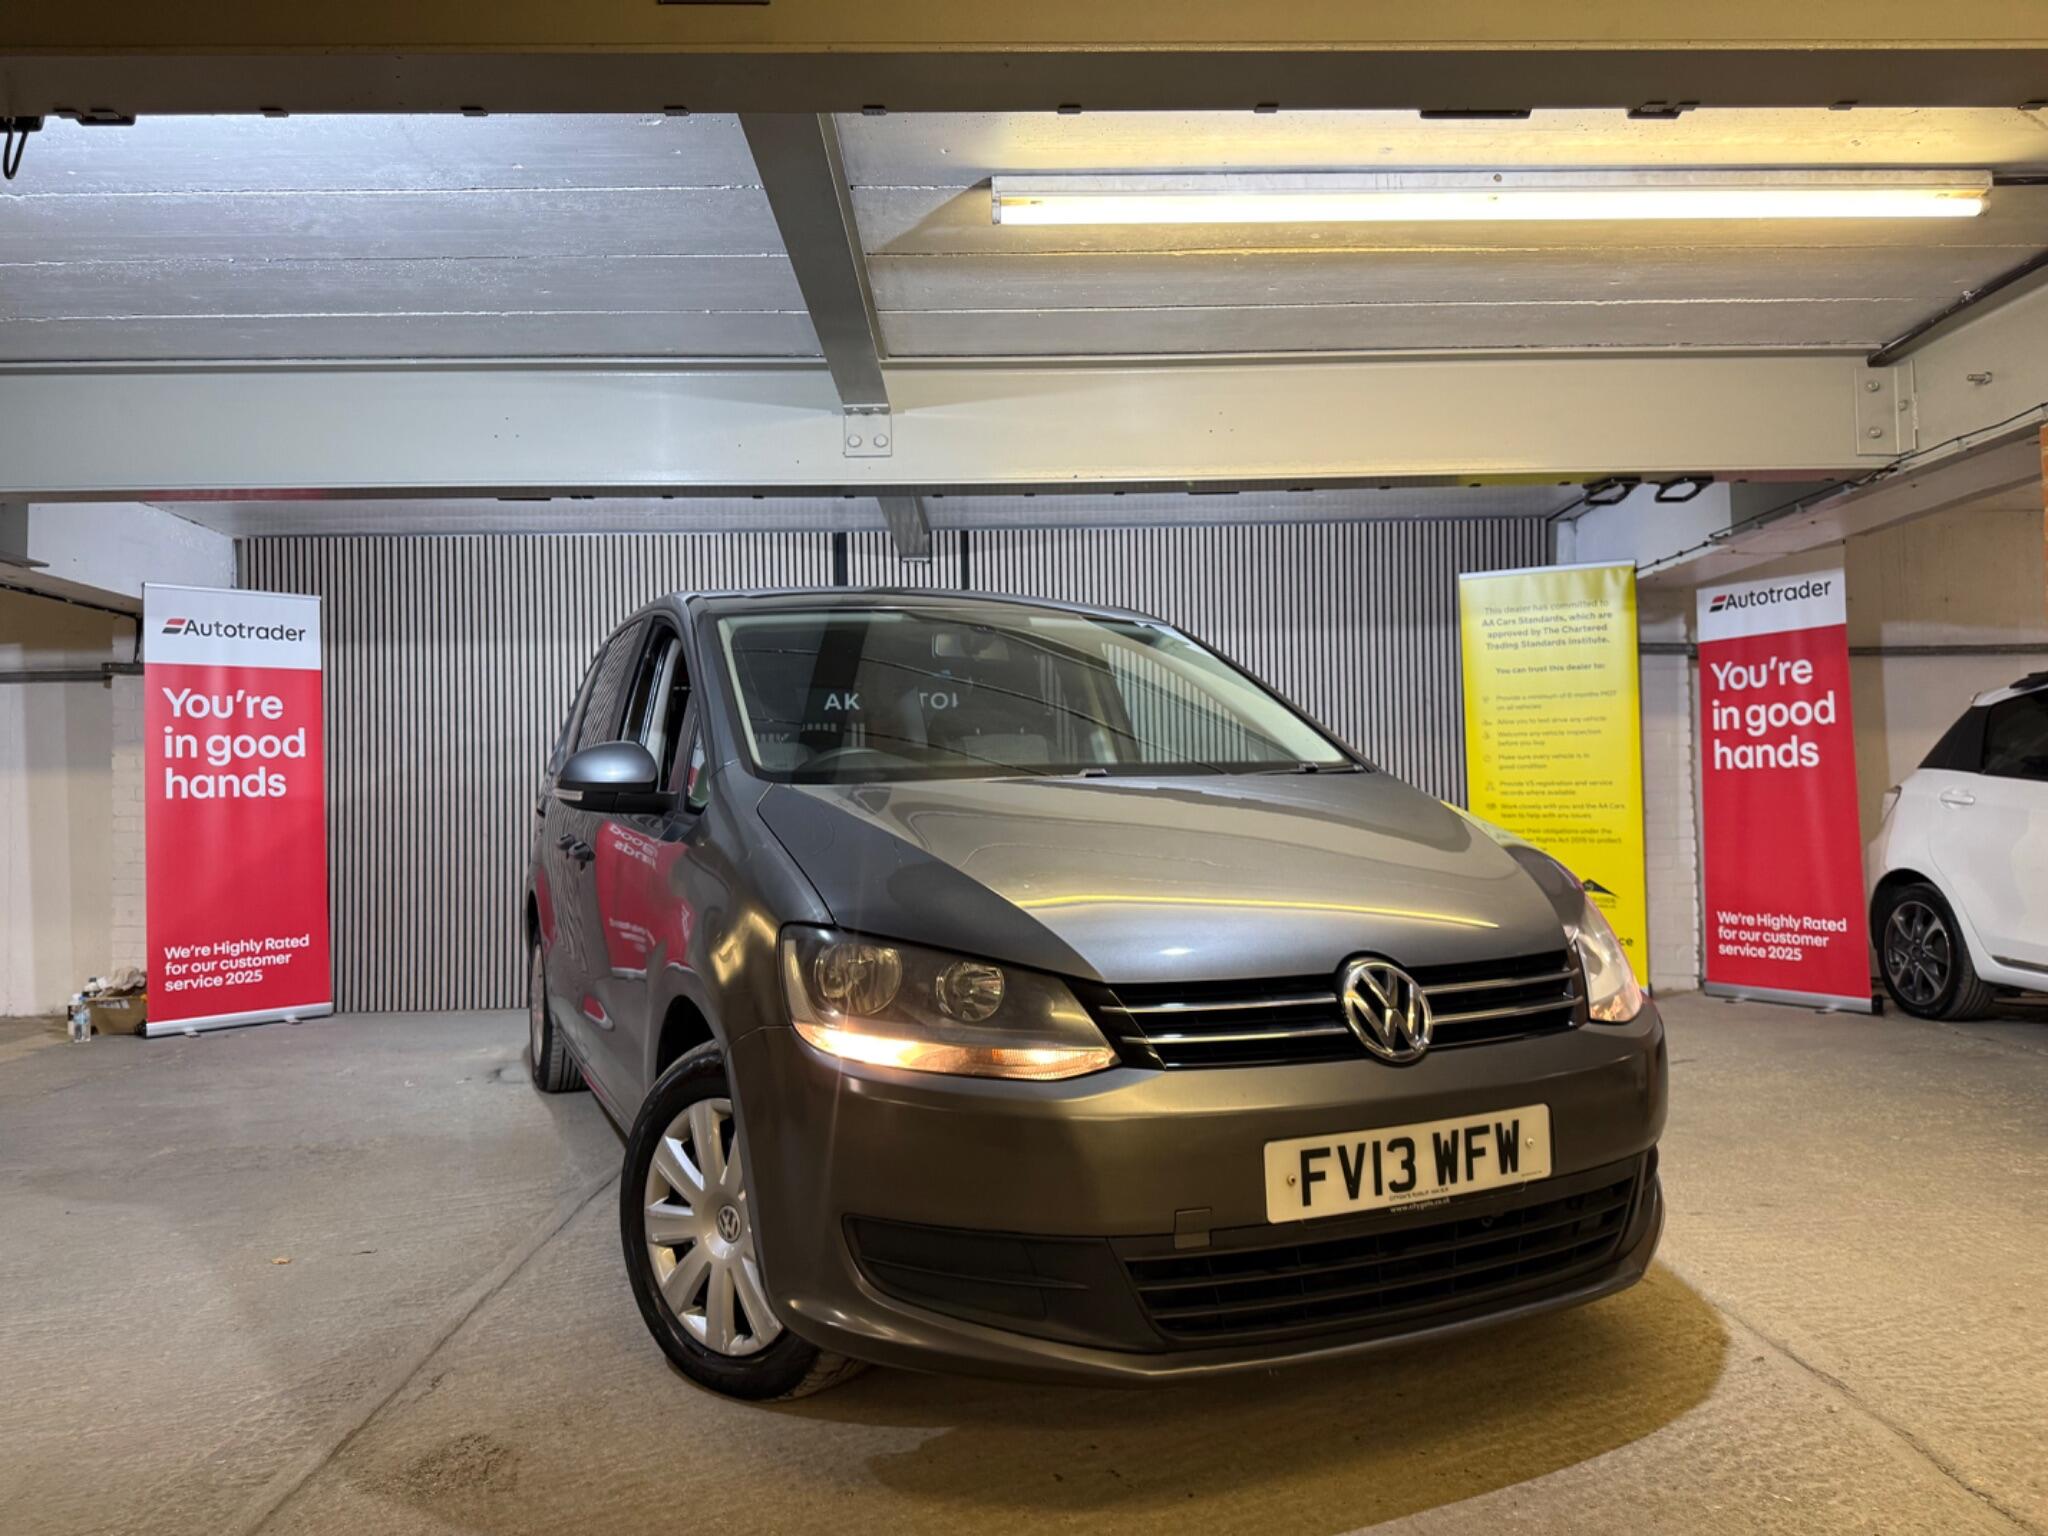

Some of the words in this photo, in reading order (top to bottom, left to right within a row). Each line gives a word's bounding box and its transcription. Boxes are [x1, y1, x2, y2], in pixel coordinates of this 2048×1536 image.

[1485, 606, 1502, 615] This
[1504, 604, 1531, 613] dealer
[1533, 603, 1548, 611] has
[1550, 600, 1597, 610] committed
[1600, 599, 1609, 607] to
[1725, 580, 1832, 611] Autotrader
[183, 619, 306, 642] Autotrader
[1482, 619, 1495, 627] AA
[1497, 618, 1516, 626] Cars
[1518, 614, 1567, 625] Standards,
[1569, 612, 1595, 621] which
[1598, 611, 1613, 619] are
[1488, 629, 1528, 639] approved
[1531, 628, 1541, 637] by
[1543, 626, 1560, 634] The
[1562, 623, 1608, 633] Chartered
[1486, 641, 1519, 651] Trading
[1521, 638, 1566, 648] Standards
[1568, 635, 1610, 645] Institute.
[1496, 666, 1510, 675] You
[1528, 665, 1548, 673] trust
[1549, 663, 1565, 672] this
[1566, 663, 1592, 671] dealer
[1710, 656, 1814, 691] You're
[162, 687, 283, 720] You're
[823, 692, 861, 711] AK
[1711, 698, 1741, 731] in
[1745, 690, 1836, 737] good
[163, 725, 198, 758] in
[205, 727, 306, 767] good
[1714, 734, 1820, 771] hands
[164, 766, 287, 800] hands
[1716, 911, 1755, 926] We're
[1756, 913, 1801, 931] Highly
[1802, 916, 1847, 932] Rated
[164, 944, 211, 960] We're
[213, 939, 263, 957] Highly
[265, 934, 310, 950] Rated
[1718, 926, 1738, 940] for
[1739, 929, 1761, 942] our
[1762, 930, 1829, 948] customer
[1718, 943, 1766, 959] service
[1767, 946, 1802, 961] 2025
[164, 962, 189, 976] for
[190, 960, 218, 974] our
[219, 952, 292, 970] customer
[164, 974, 223, 992] service
[225, 969, 264, 986] 2025
[1300, 1136, 1417, 1207] FV13
[1432, 1119, 1520, 1187] WFW
